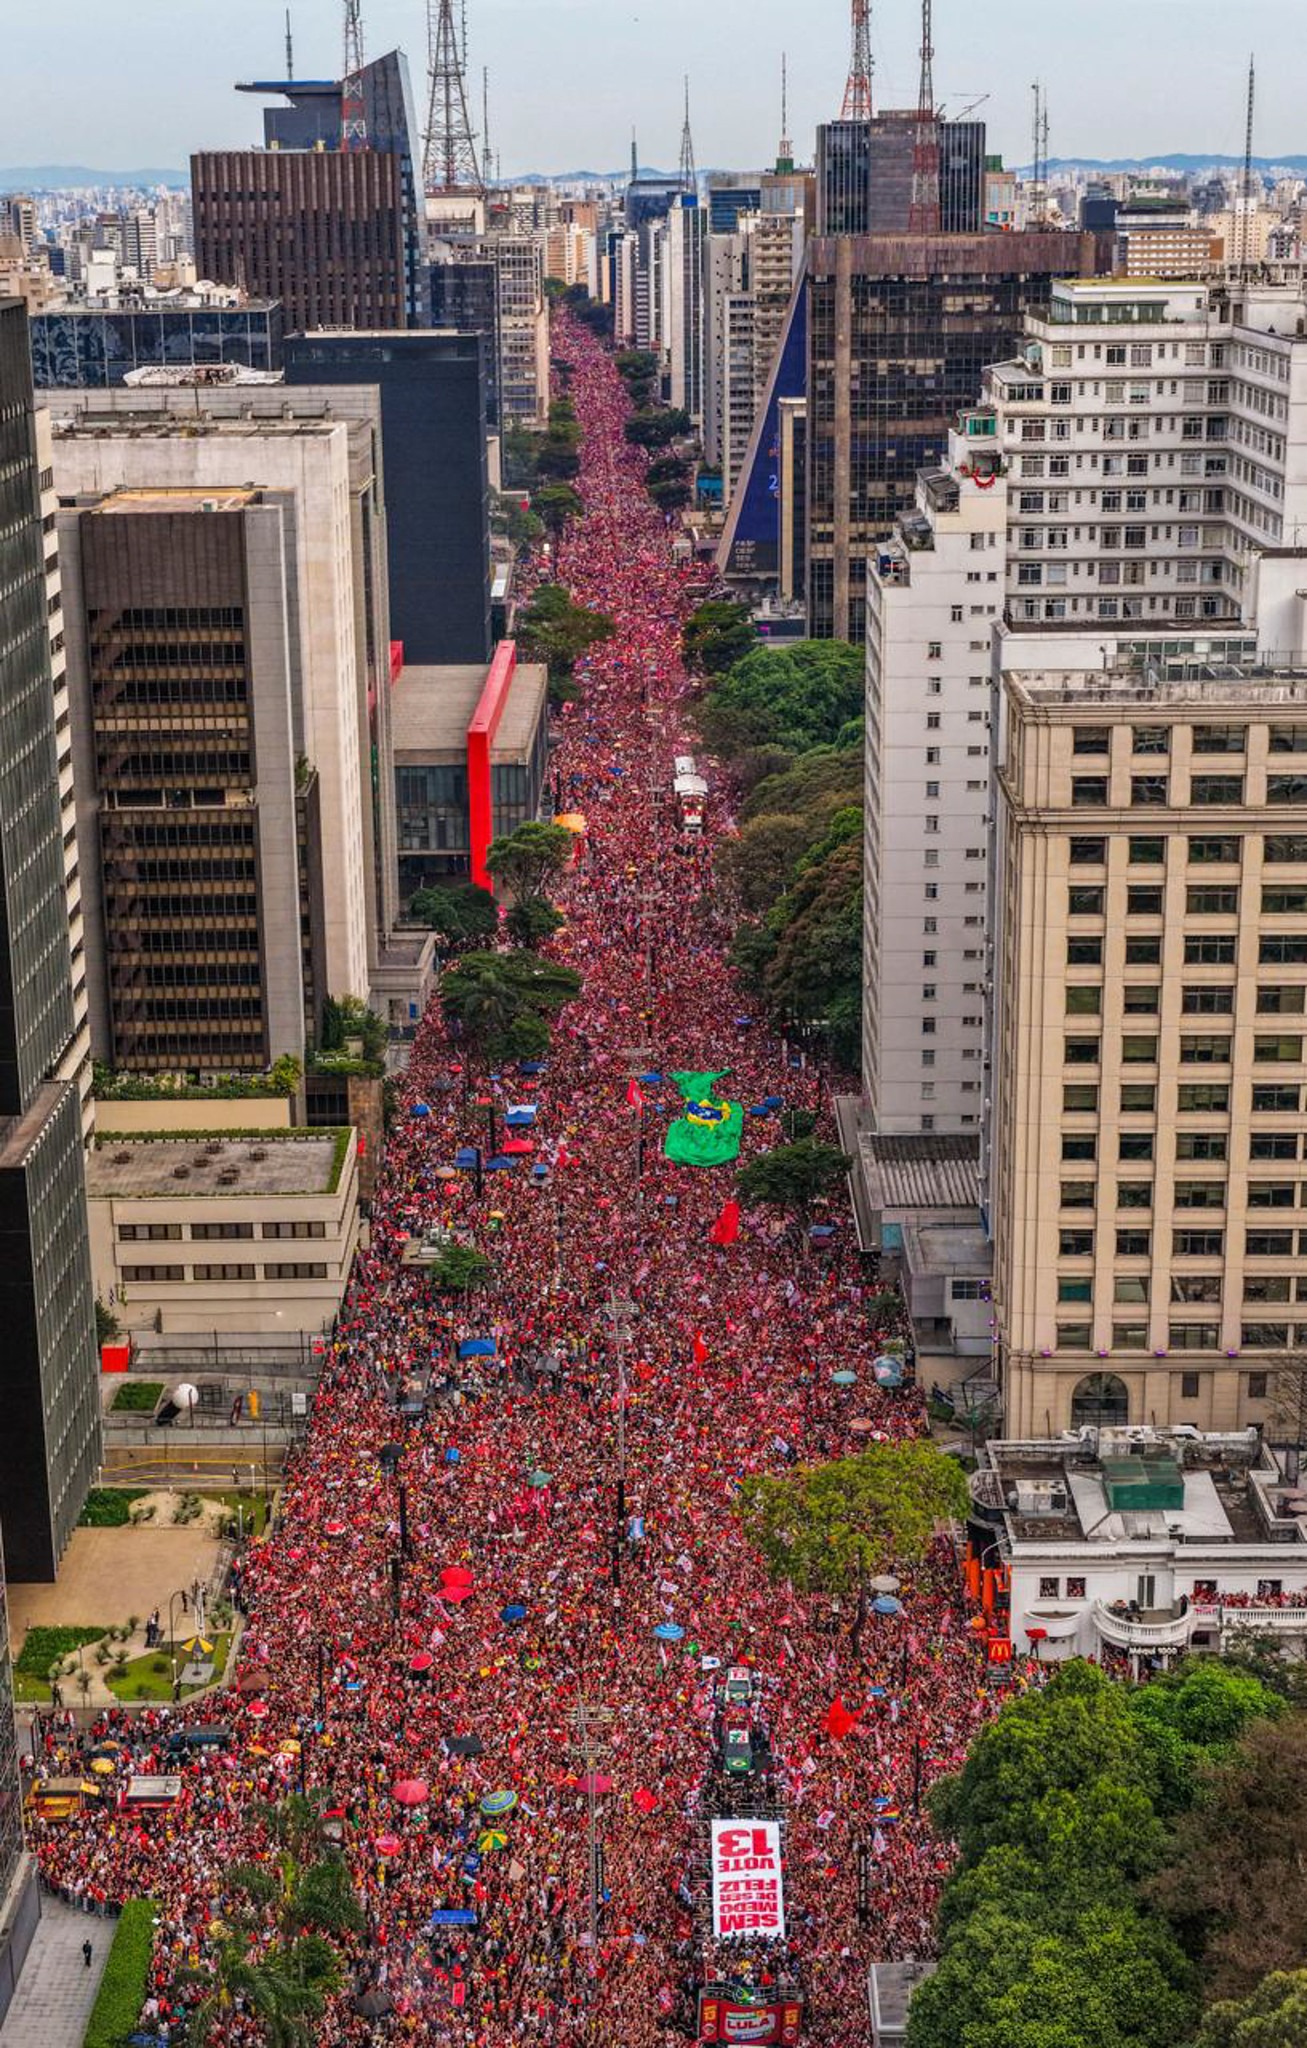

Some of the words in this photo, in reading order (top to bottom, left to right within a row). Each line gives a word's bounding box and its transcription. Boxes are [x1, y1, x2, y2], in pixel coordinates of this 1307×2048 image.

[717, 1828, 774, 1857] 13
[718, 1857, 775, 1873] VOTE
[719, 1878, 777, 1893] FELIZ
[720, 1892, 753, 1902] SER
[756, 1892, 777, 1901] DE
[719, 1901, 778, 1914] MEDO
[719, 1913, 778, 1933] SEM
[727, 2017, 770, 2030] LULA
